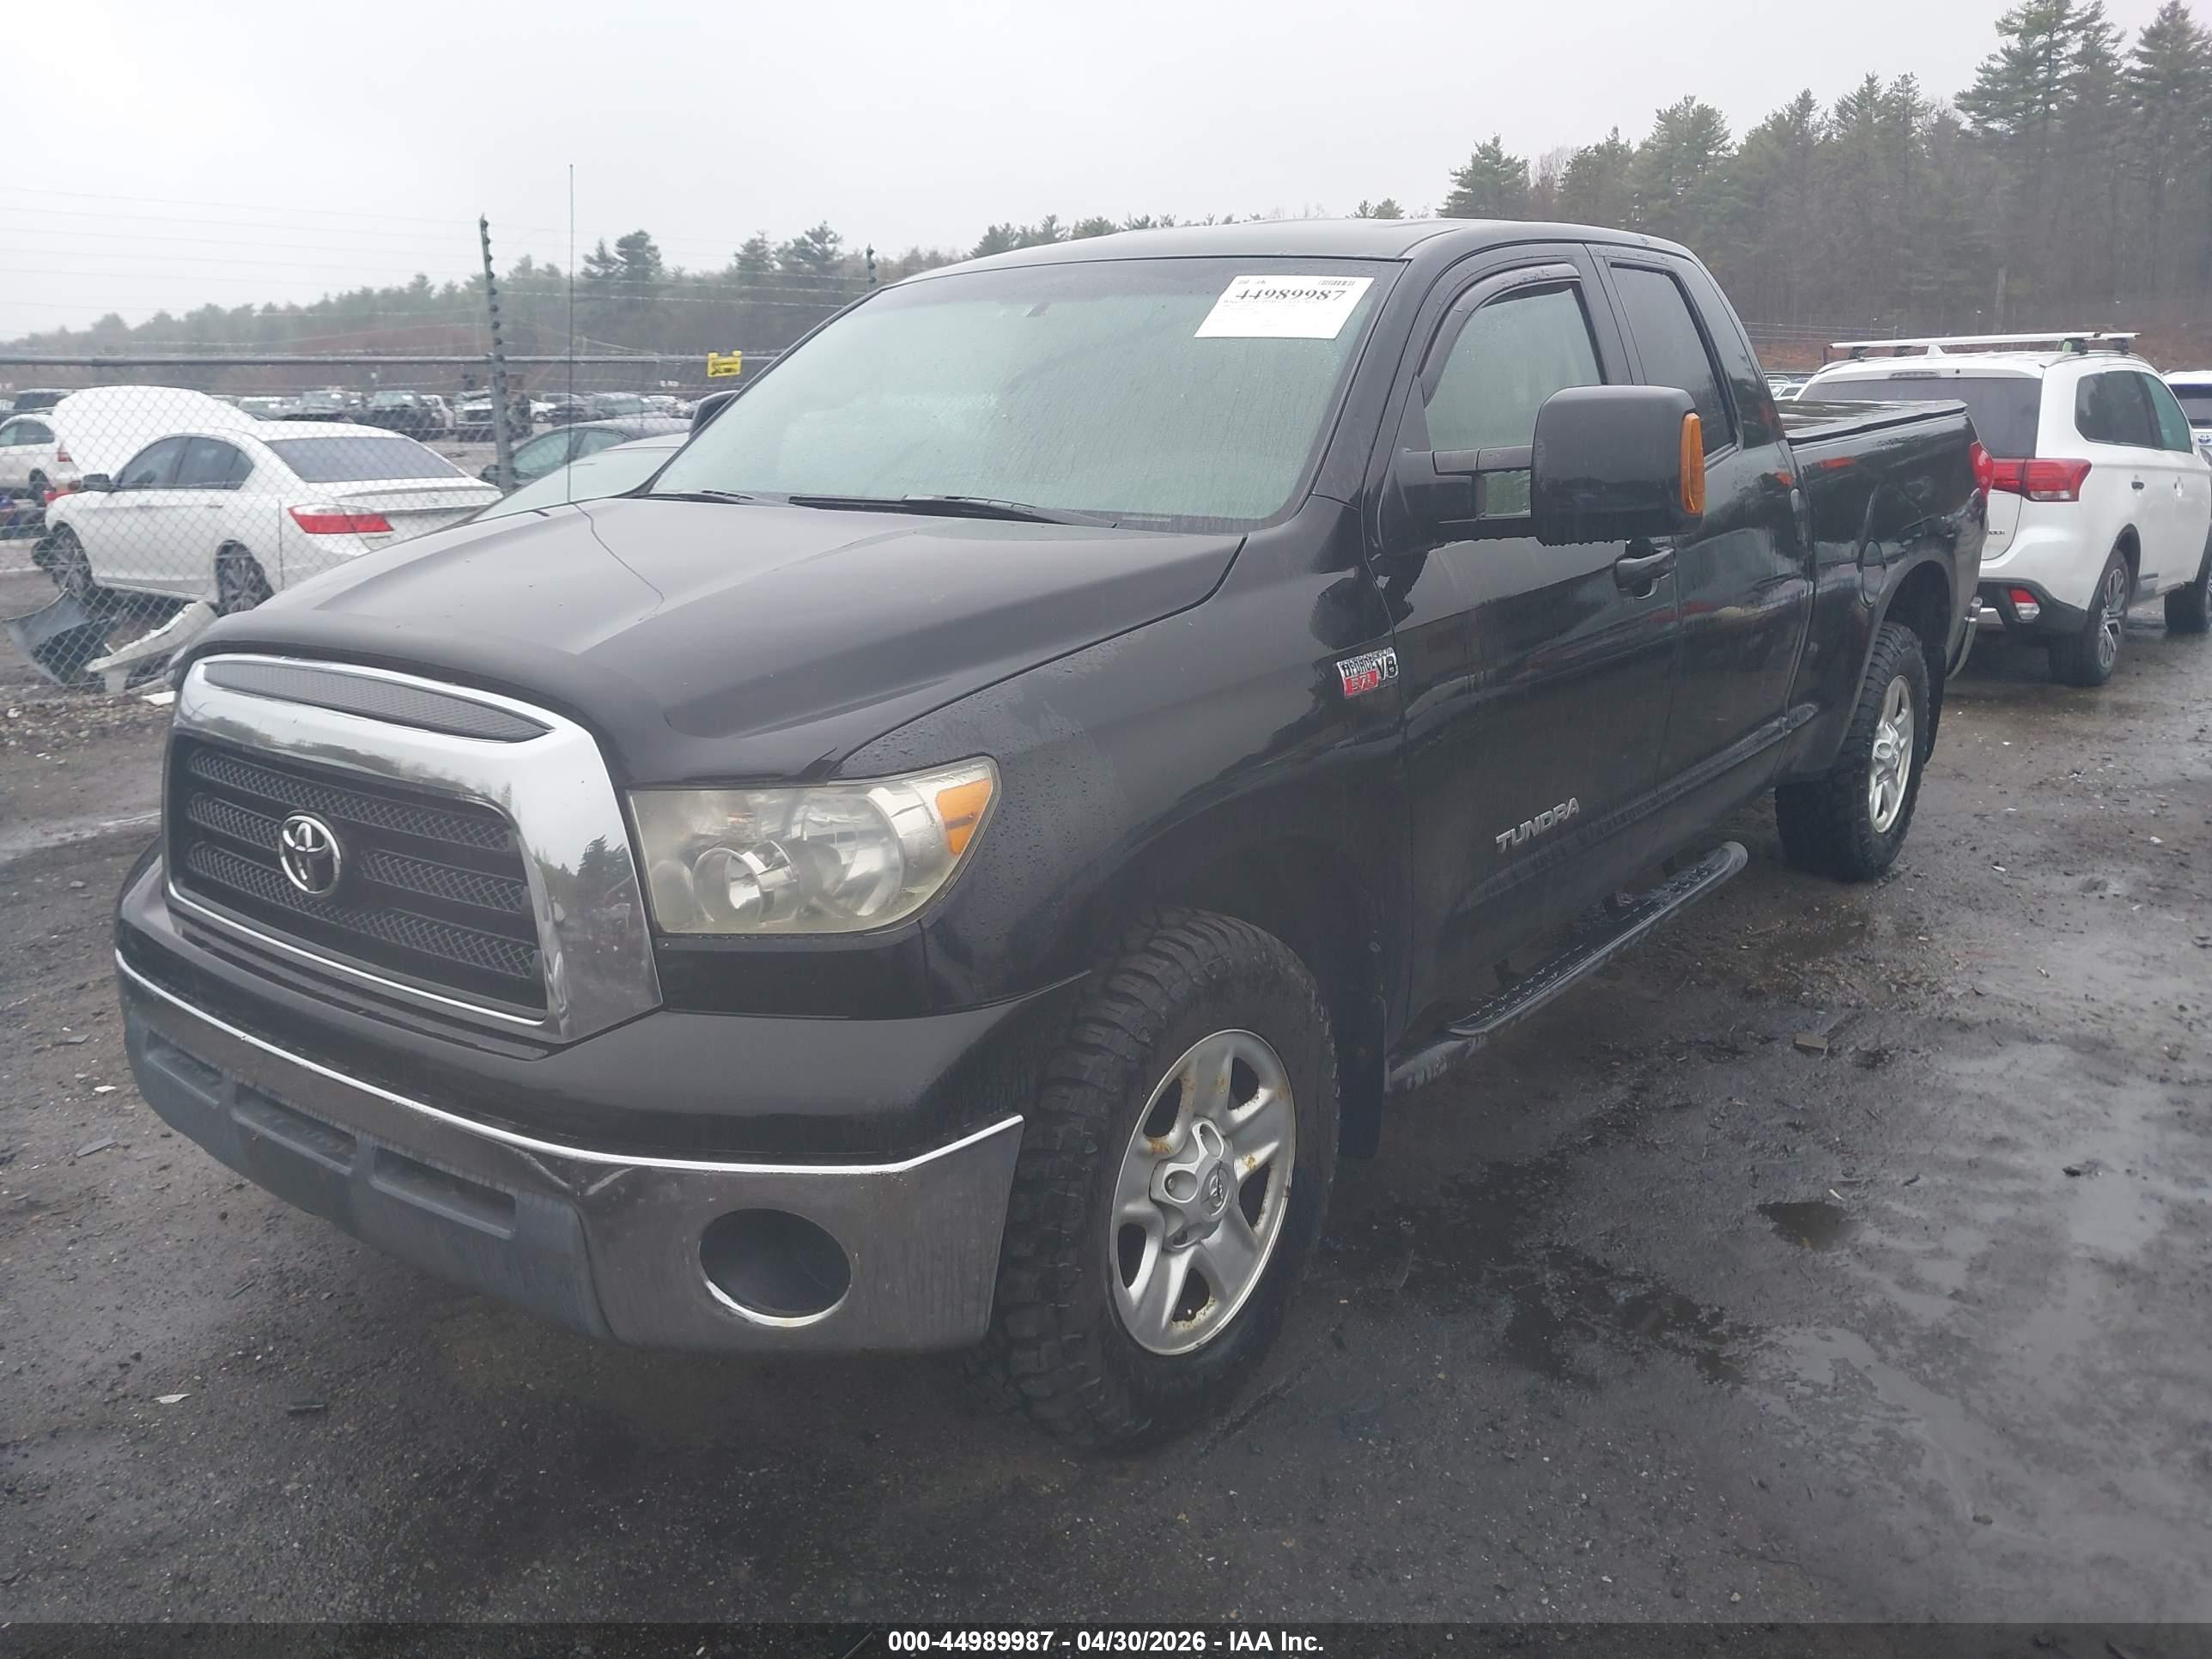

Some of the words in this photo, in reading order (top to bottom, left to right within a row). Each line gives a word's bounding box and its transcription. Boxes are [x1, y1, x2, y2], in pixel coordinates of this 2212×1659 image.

[1236, 288, 1346, 301] 44989987
[1376, 654, 1397, 680] V8
[1495, 797, 1580, 854] TUNDRA
